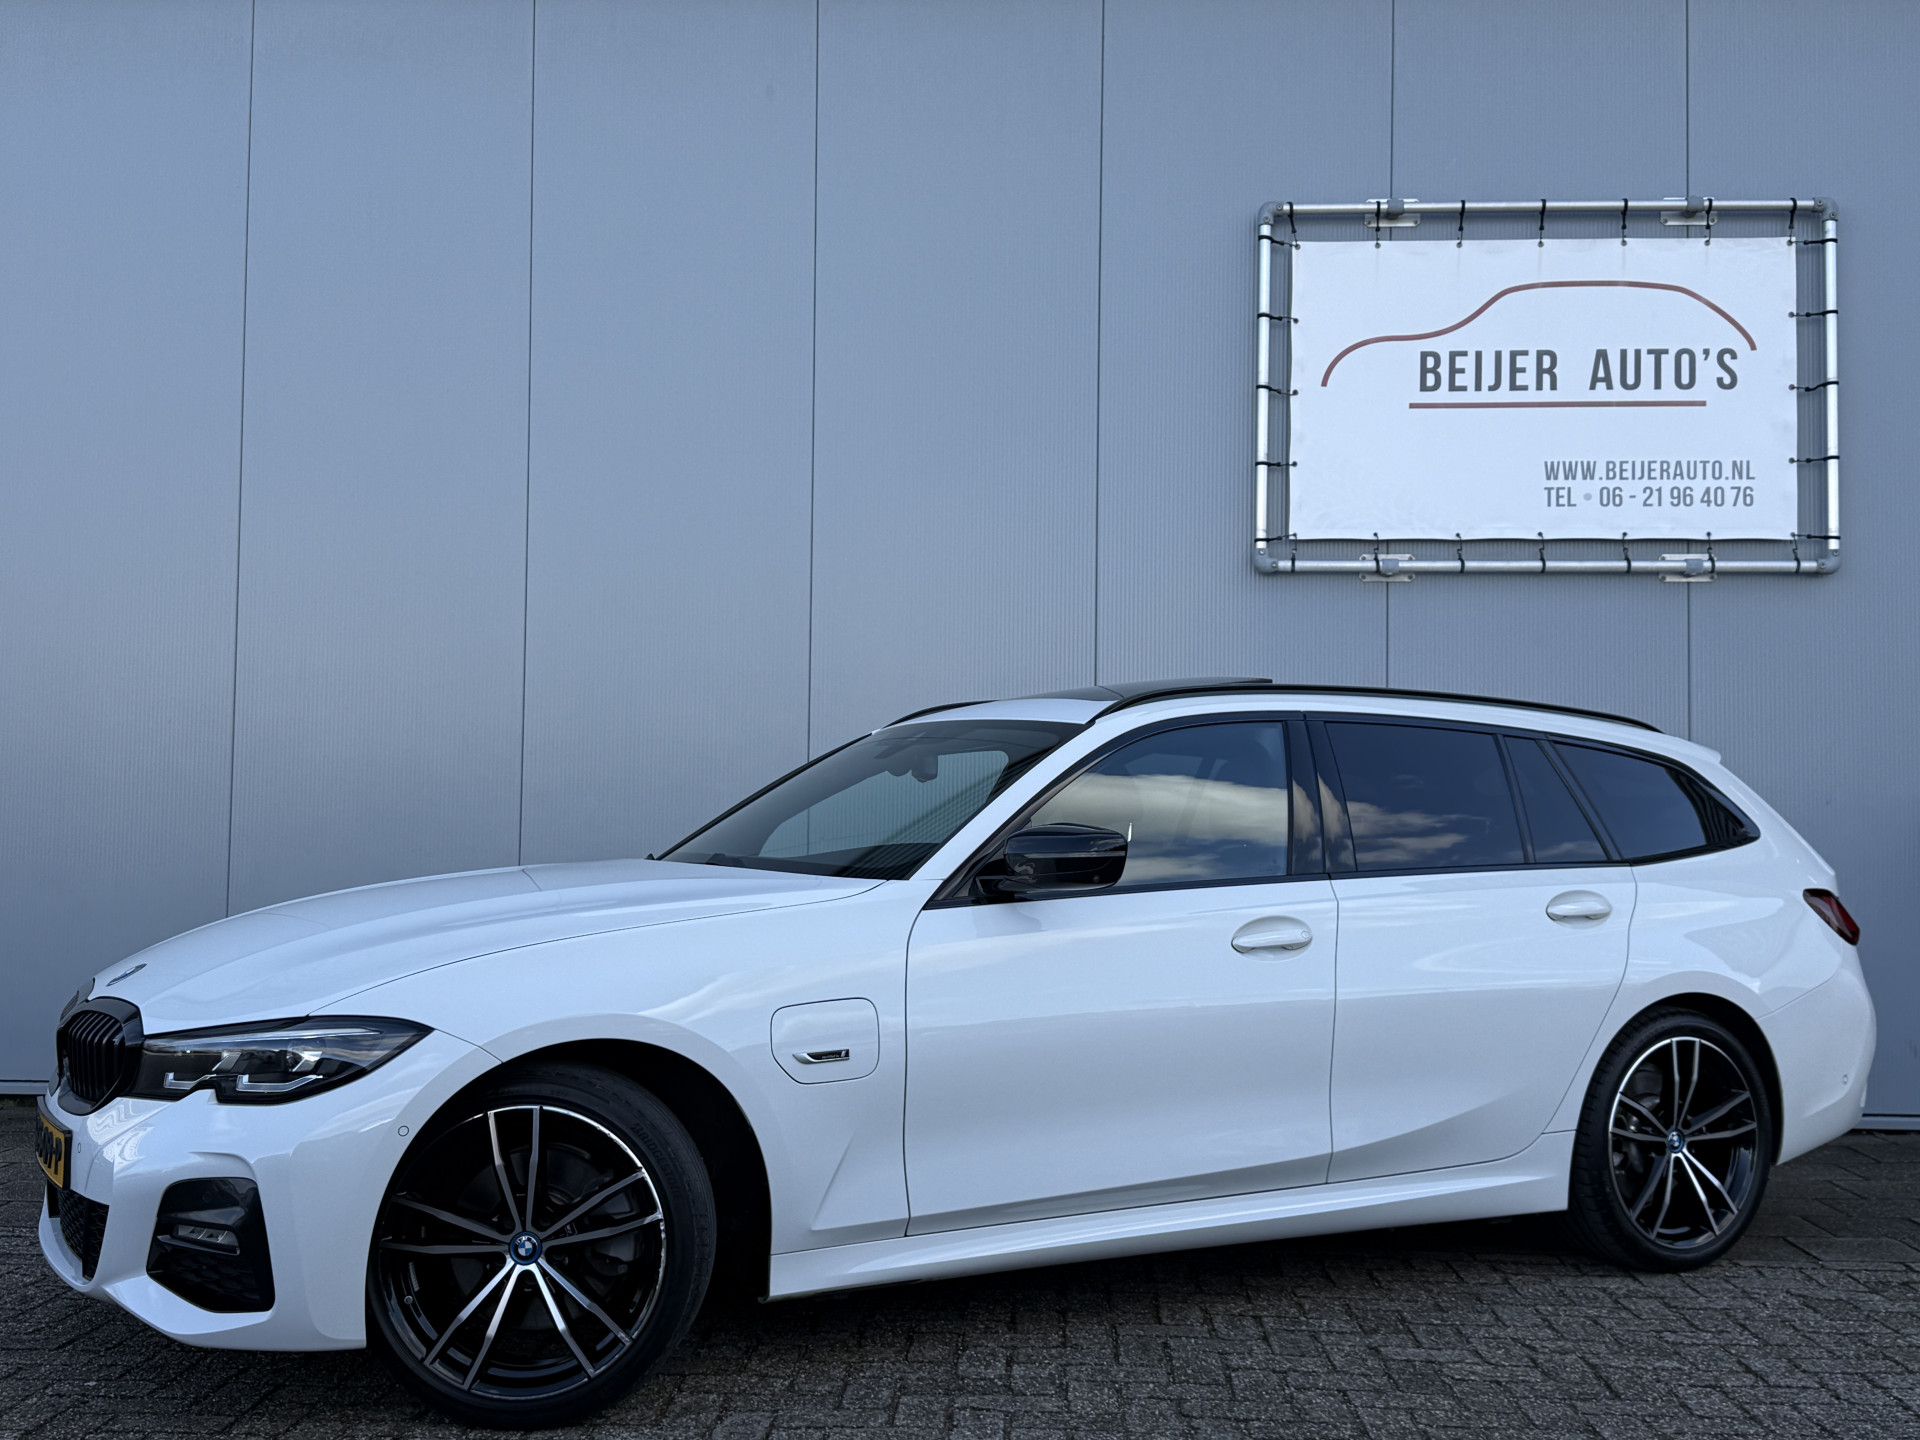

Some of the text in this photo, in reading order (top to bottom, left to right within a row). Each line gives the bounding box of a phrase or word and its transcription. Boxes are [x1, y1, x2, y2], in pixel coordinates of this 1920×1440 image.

[1419, 347, 1738, 392] BEIJER AUTO'S
[1544, 459, 1756, 481] WWW.BEIJERAUTO.NL
[1544, 486, 1577, 507] TEL
[1599, 486, 1624, 507] 06
[1642, 486, 1663, 507] 21
[1669, 486, 1694, 507] 96
[1699, 486, 1725, 507] 40
[1730, 486, 1754, 507] 76
[630, 1123, 682, 1200] BRIDGESTONE
